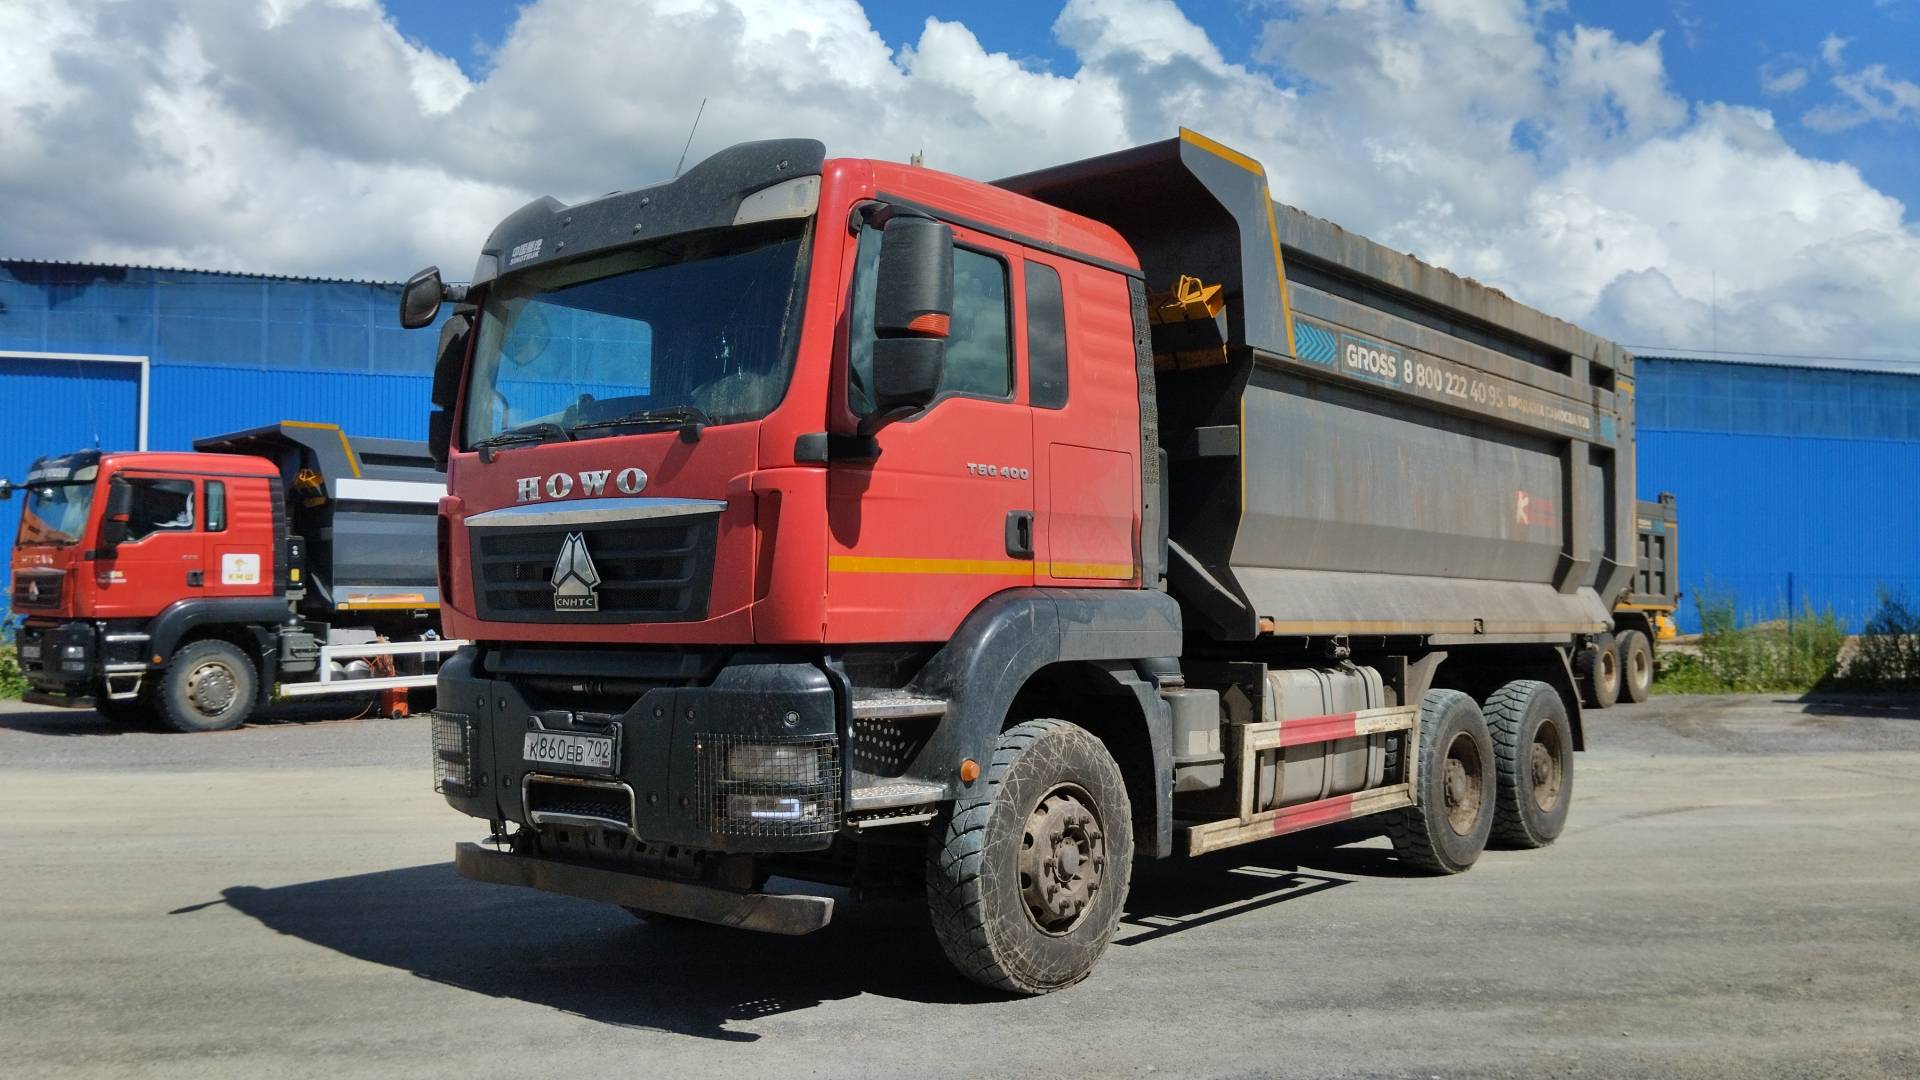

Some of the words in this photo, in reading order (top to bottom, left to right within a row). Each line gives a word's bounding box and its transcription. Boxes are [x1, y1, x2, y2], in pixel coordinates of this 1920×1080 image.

[1346, 343, 1397, 378] GROSS
[1403, 359, 1413, 384] 8
[1416, 363, 1442, 392] 800
[1445, 372, 1468, 399] 222
[1470, 380, 1486, 404] 40
[1488, 385, 1504, 408] 95
[967, 462, 997, 476] T5G
[1000, 466, 1029, 480] 400
[516, 467, 648, 502] HOWO
[556, 597, 594, 607] CNHTC
[587, 739, 609, 758] 702
